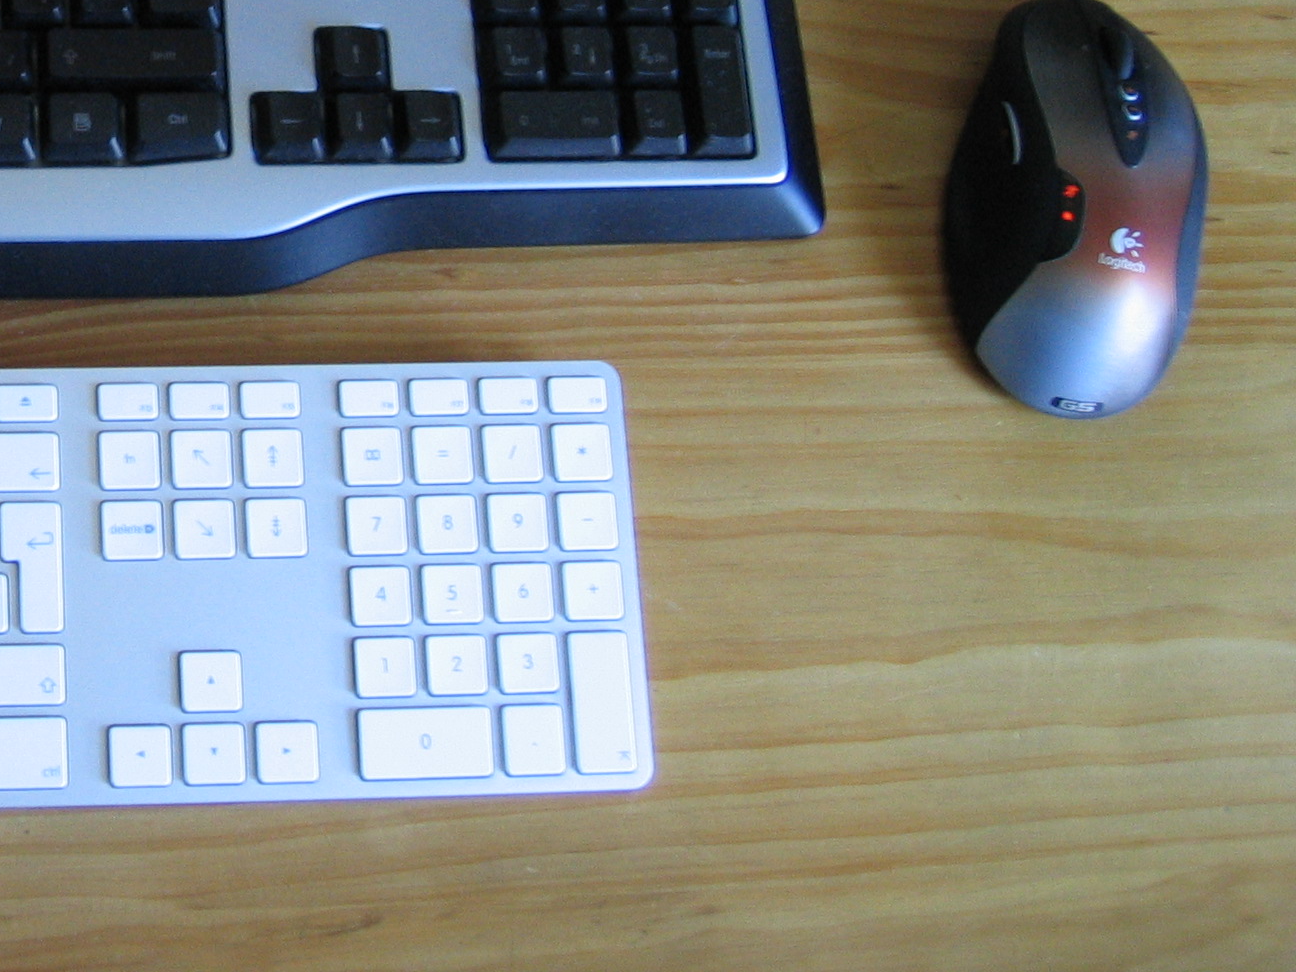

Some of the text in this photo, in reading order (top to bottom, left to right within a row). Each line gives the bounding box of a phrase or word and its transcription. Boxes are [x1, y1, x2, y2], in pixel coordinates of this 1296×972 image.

[373, 516, 381, 531] 7
[443, 515, 453, 530] 8
[513, 513, 523, 527] 9
[376, 587, 386, 600] 4
[448, 585, 457, 601] 5
[519, 585, 529, 598] 6
[453, 656, 462, 672] 2
[524, 654, 534, 669] 3
[420, 734, 431, 750] 0
